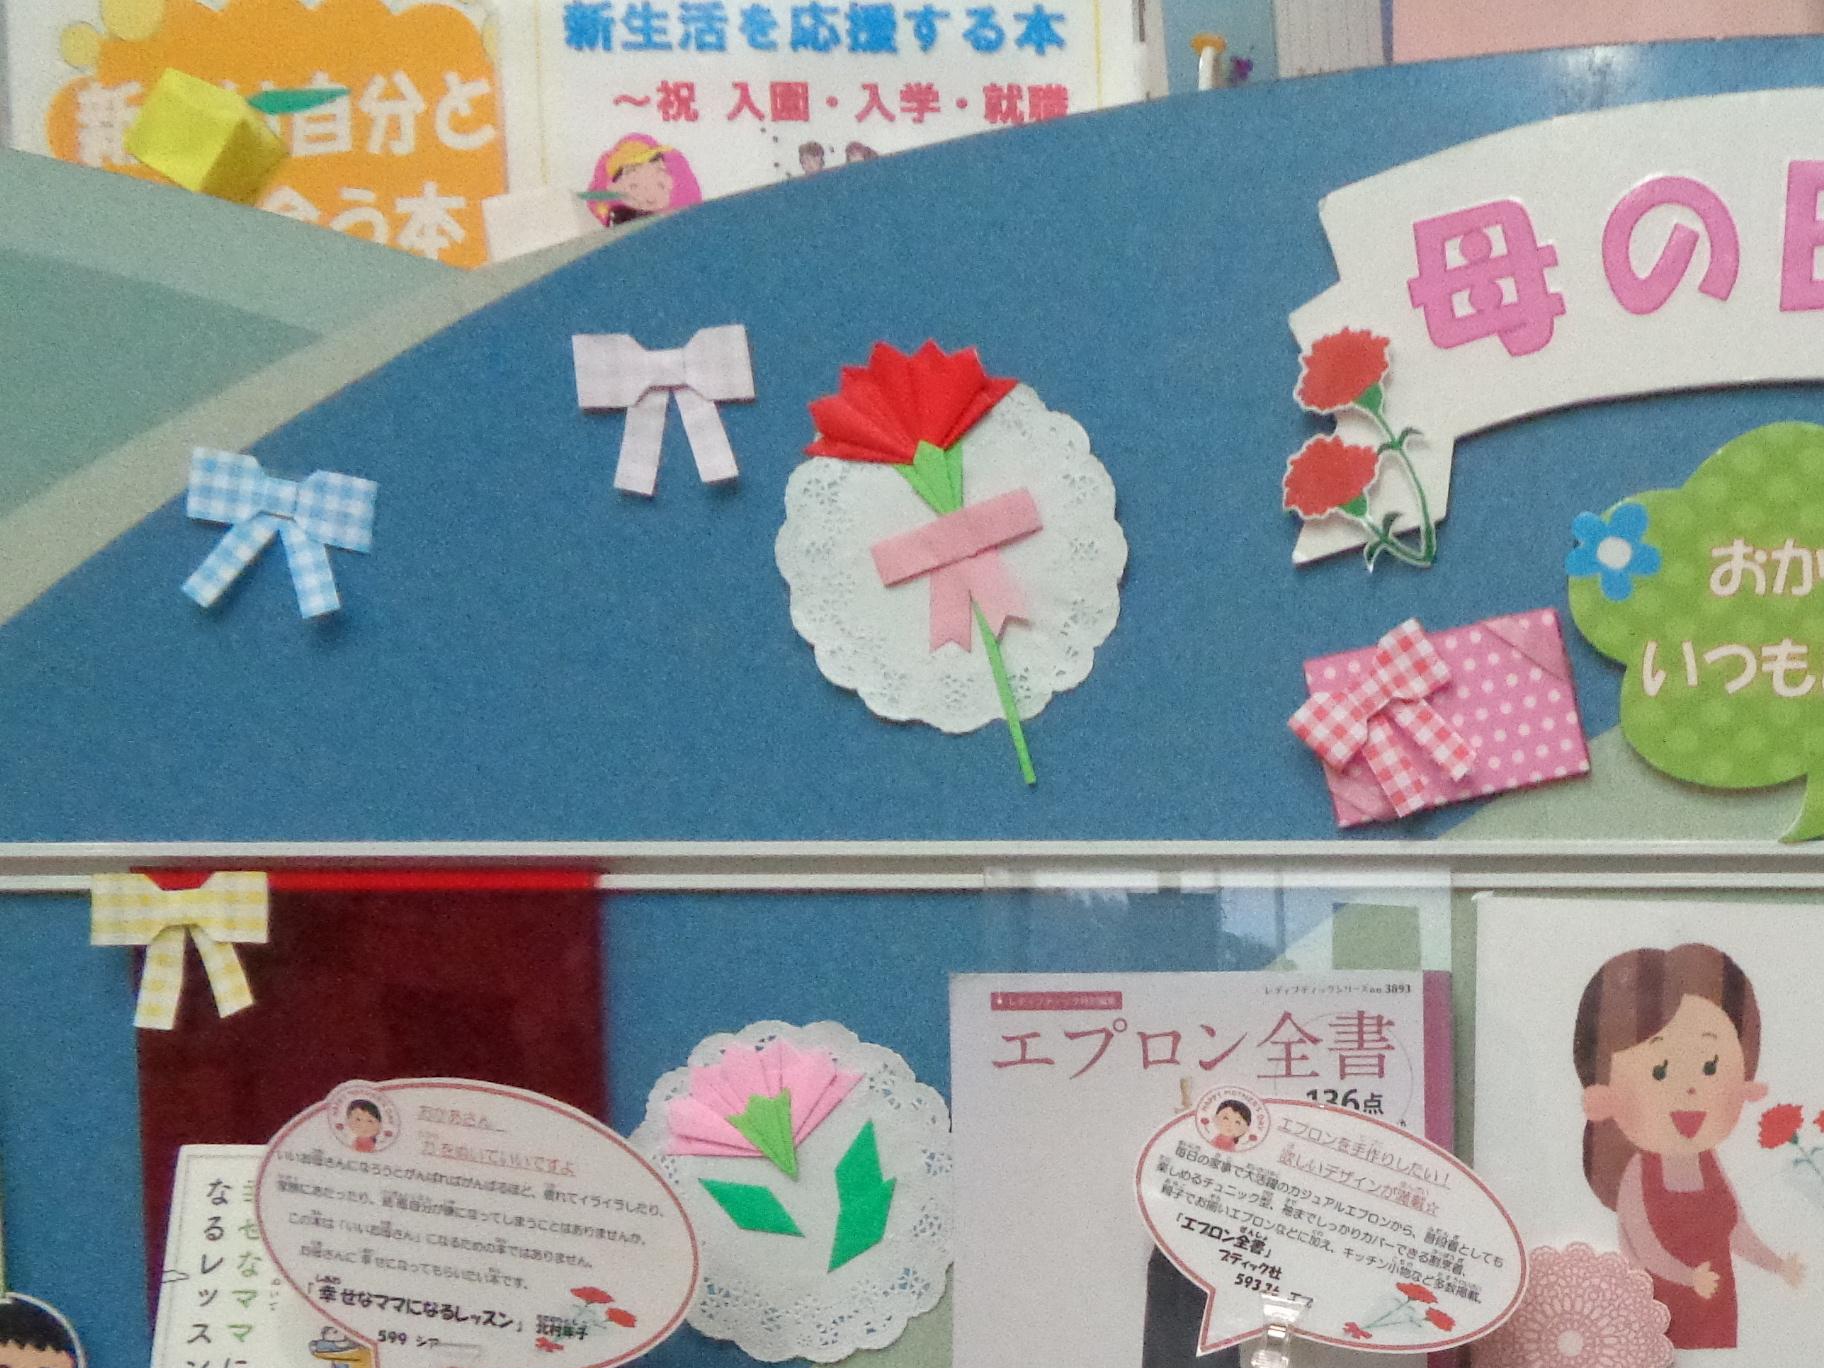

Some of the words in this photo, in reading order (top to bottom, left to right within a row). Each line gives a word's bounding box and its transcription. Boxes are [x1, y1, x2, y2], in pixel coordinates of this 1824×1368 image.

[563, 3, 1066, 56] 新生活を応援する本
[992, 1010, 1396, 1080] エプロン全書
[1176, 1213, 1272, 1259] 「エプロン全書」
[378, 1330, 406, 1345] 599
